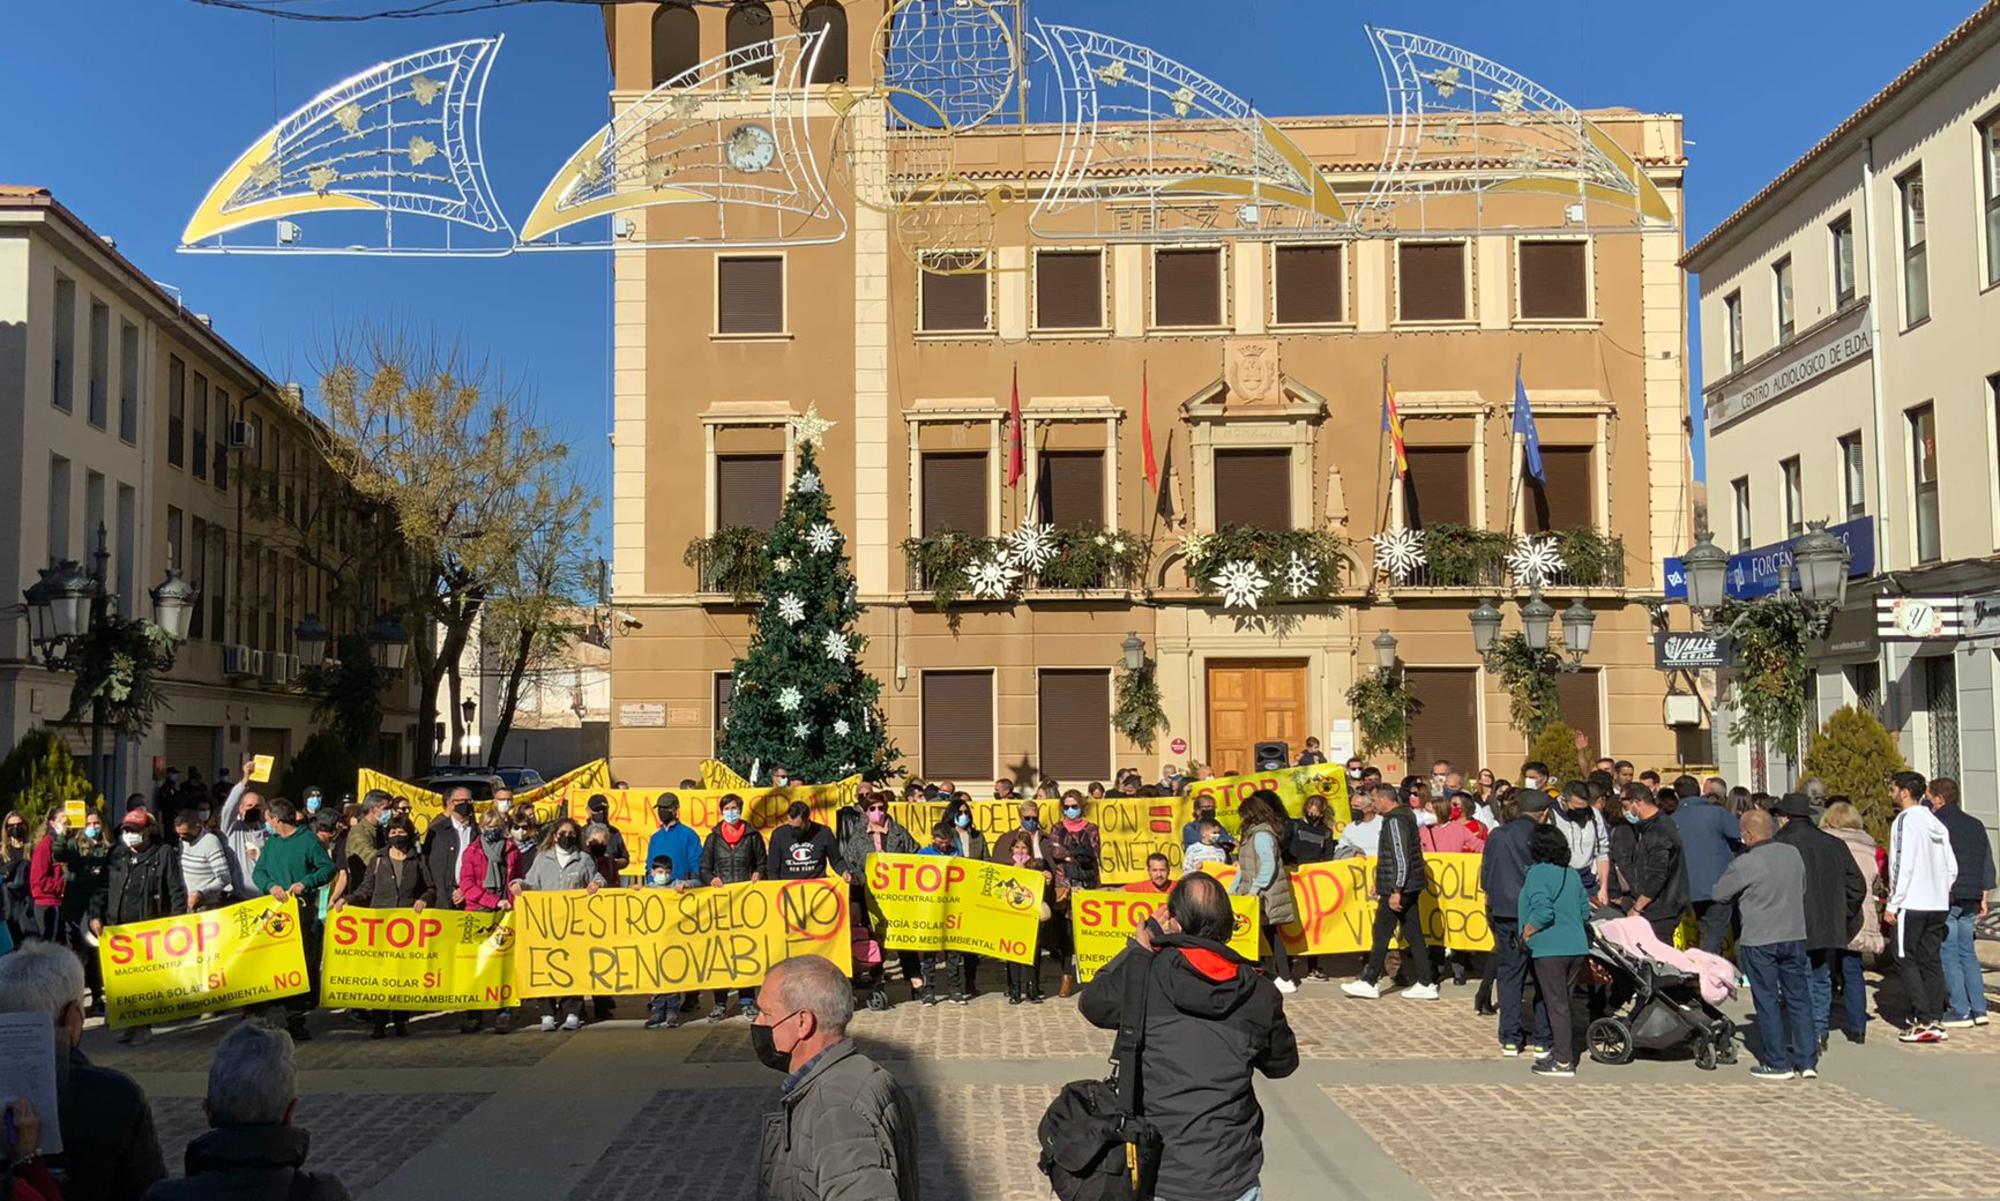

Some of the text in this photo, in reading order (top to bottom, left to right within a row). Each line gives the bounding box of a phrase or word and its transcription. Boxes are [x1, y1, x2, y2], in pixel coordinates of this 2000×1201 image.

[1740, 331, 1873, 410] CENTRO AUDIOLOGICO DE ELDA
[1751, 545, 1793, 583] FORCÉN
[980, 803, 1004, 833] DE
[872, 861, 966, 893] STOP
[522, 884, 841, 941] NUESTRO SUELO NO
[912, 920, 944, 930] SOLAR
[945, 912, 963, 930] SÍ
[1080, 899, 1168, 928] STO
[109, 921, 221, 966] STOP
[333, 915, 443, 949] STOP
[918, 935, 995, 951] MEDIAMBIENTAL
[999, 938, 1028, 957] NO
[114, 960, 184, 977] MACROCENTRA
[334, 948, 439, 960] MACROCENTRAL SOLAR
[529, 945, 574, 989] ES
[116, 967, 227, 1006] ENERGÍA SOLAR SÍ
[328, 984, 513, 1004] ATENTADO MEDIOAMBIENTAL NO
[329, 968, 442, 989] ENERGÍA SOLAR SÍ
[118, 971, 302, 1021] ATENTADO MEDIOAMBIENTAL NO
